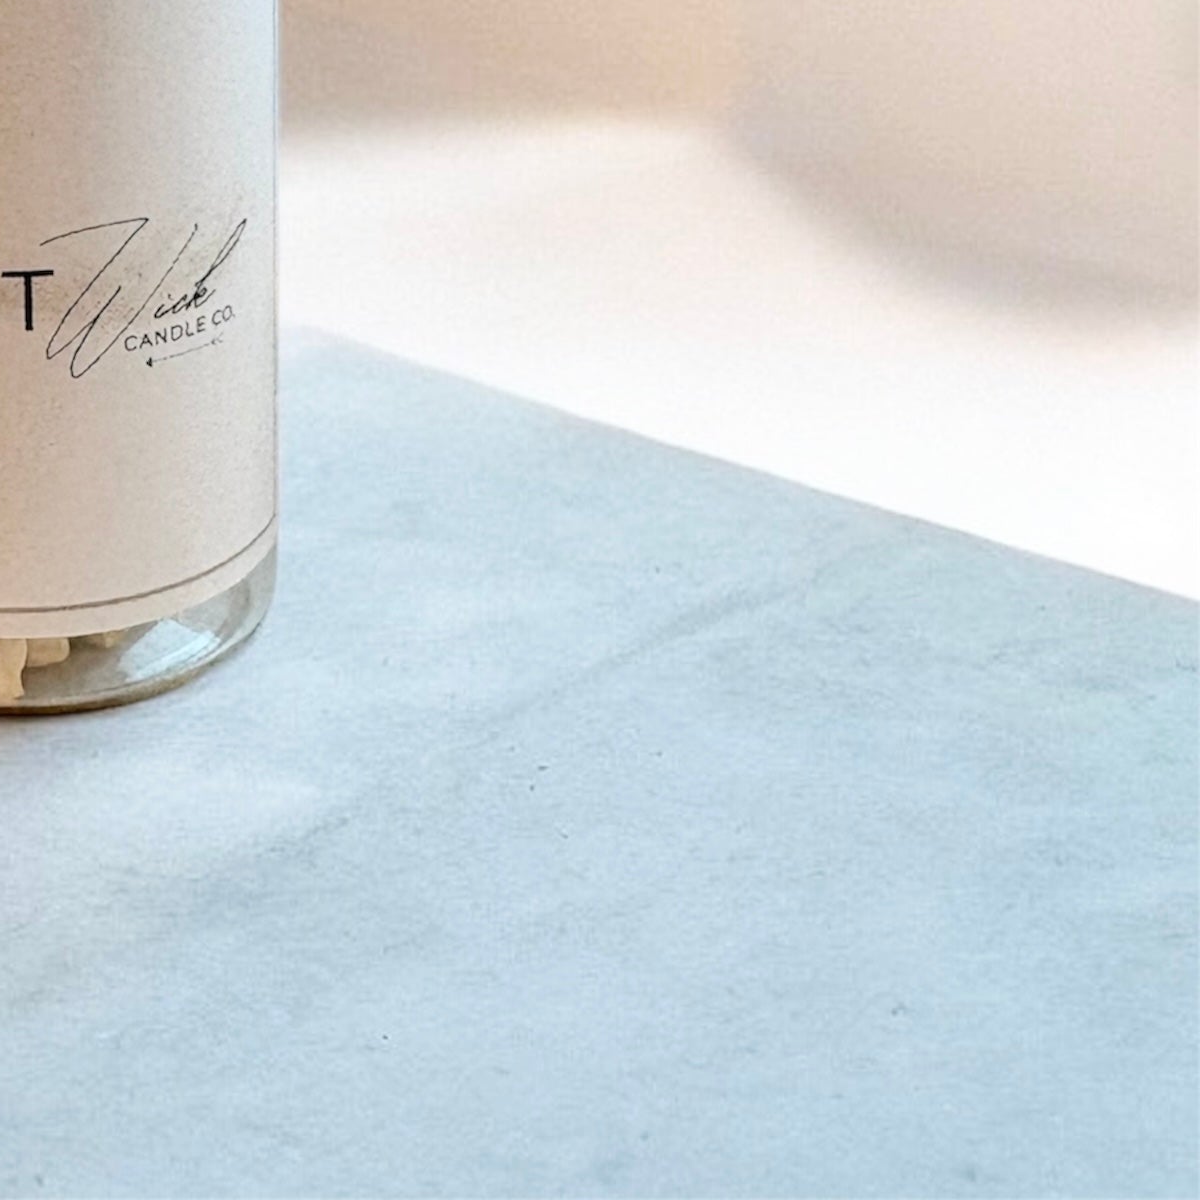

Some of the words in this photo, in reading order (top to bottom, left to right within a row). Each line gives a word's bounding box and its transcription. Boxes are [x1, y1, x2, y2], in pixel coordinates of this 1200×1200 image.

[40, 217, 247, 379] Wick
[124, 315, 206, 352] CANDLE
[211, 304, 236, 327] CO.
